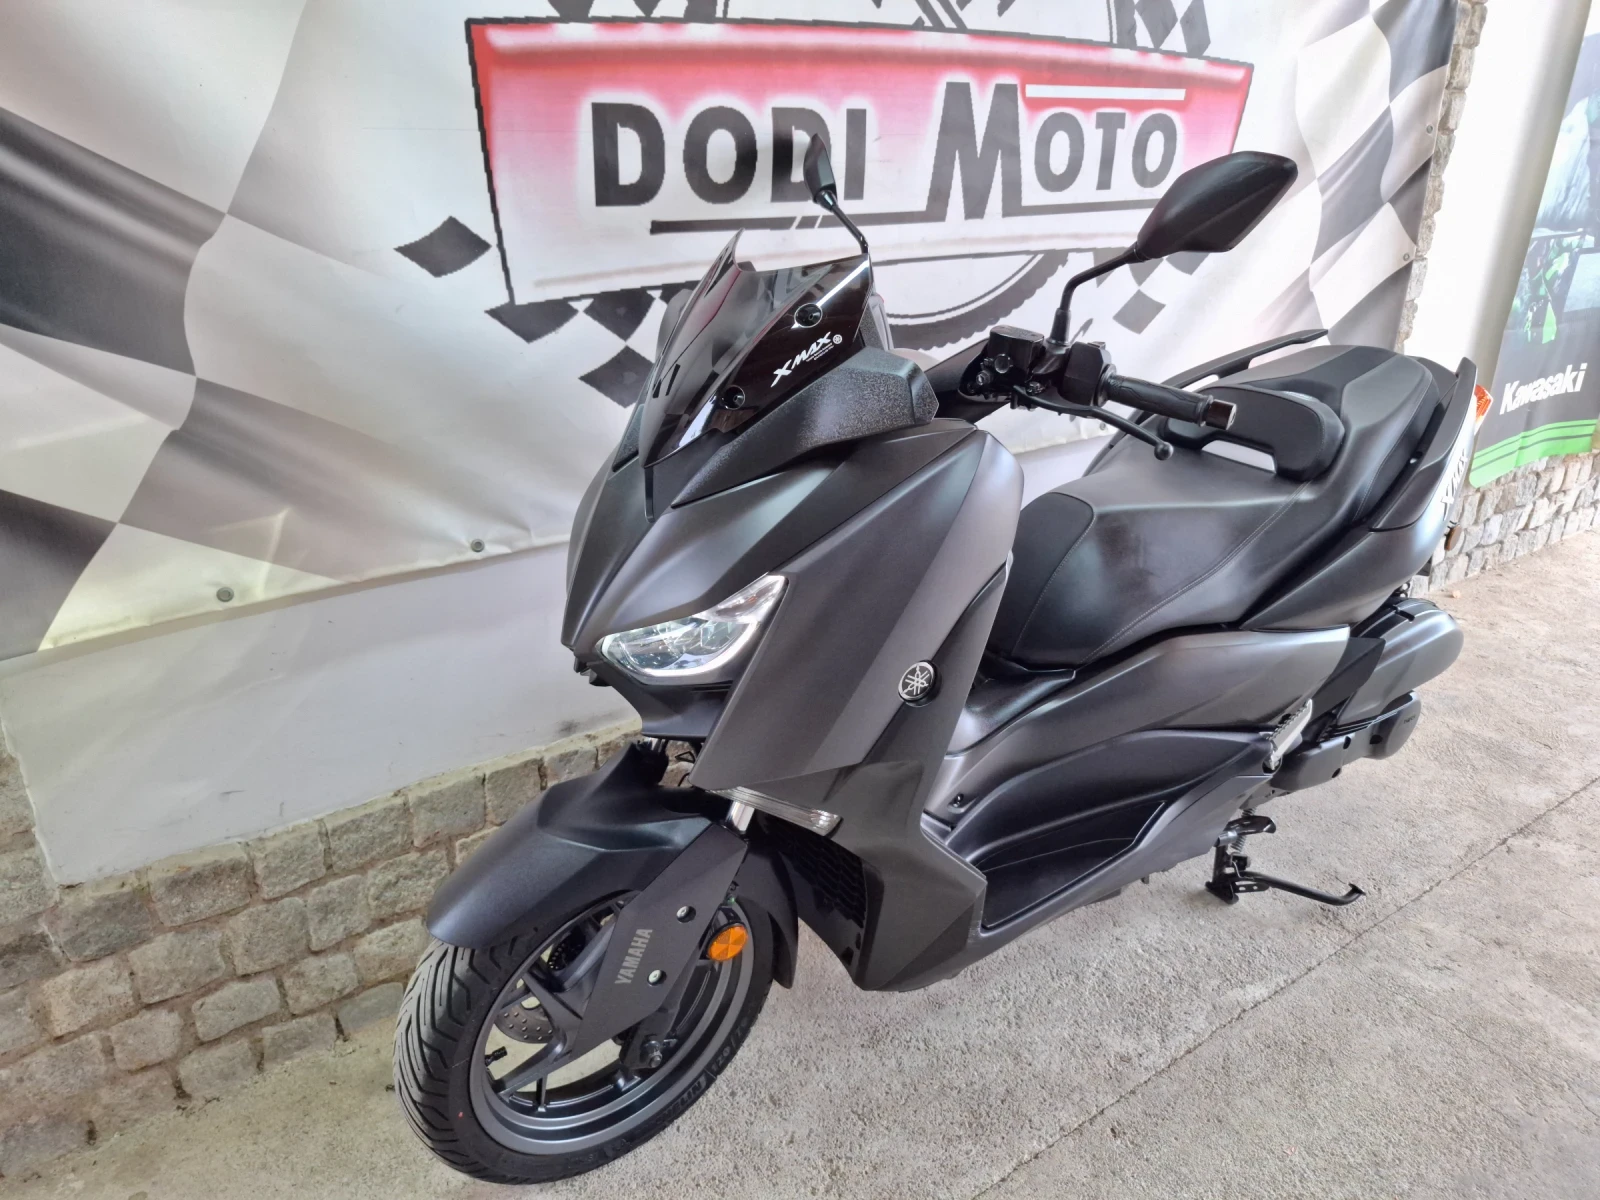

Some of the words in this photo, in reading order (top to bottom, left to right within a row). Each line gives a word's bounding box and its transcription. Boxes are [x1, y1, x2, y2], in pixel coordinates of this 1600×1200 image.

[591, 102, 867, 207] DODI
[925, 82, 1178, 220] MOTO
[1499, 362, 1588, 415] Kawasaki
[614, 929, 653, 984] YAMAHA
